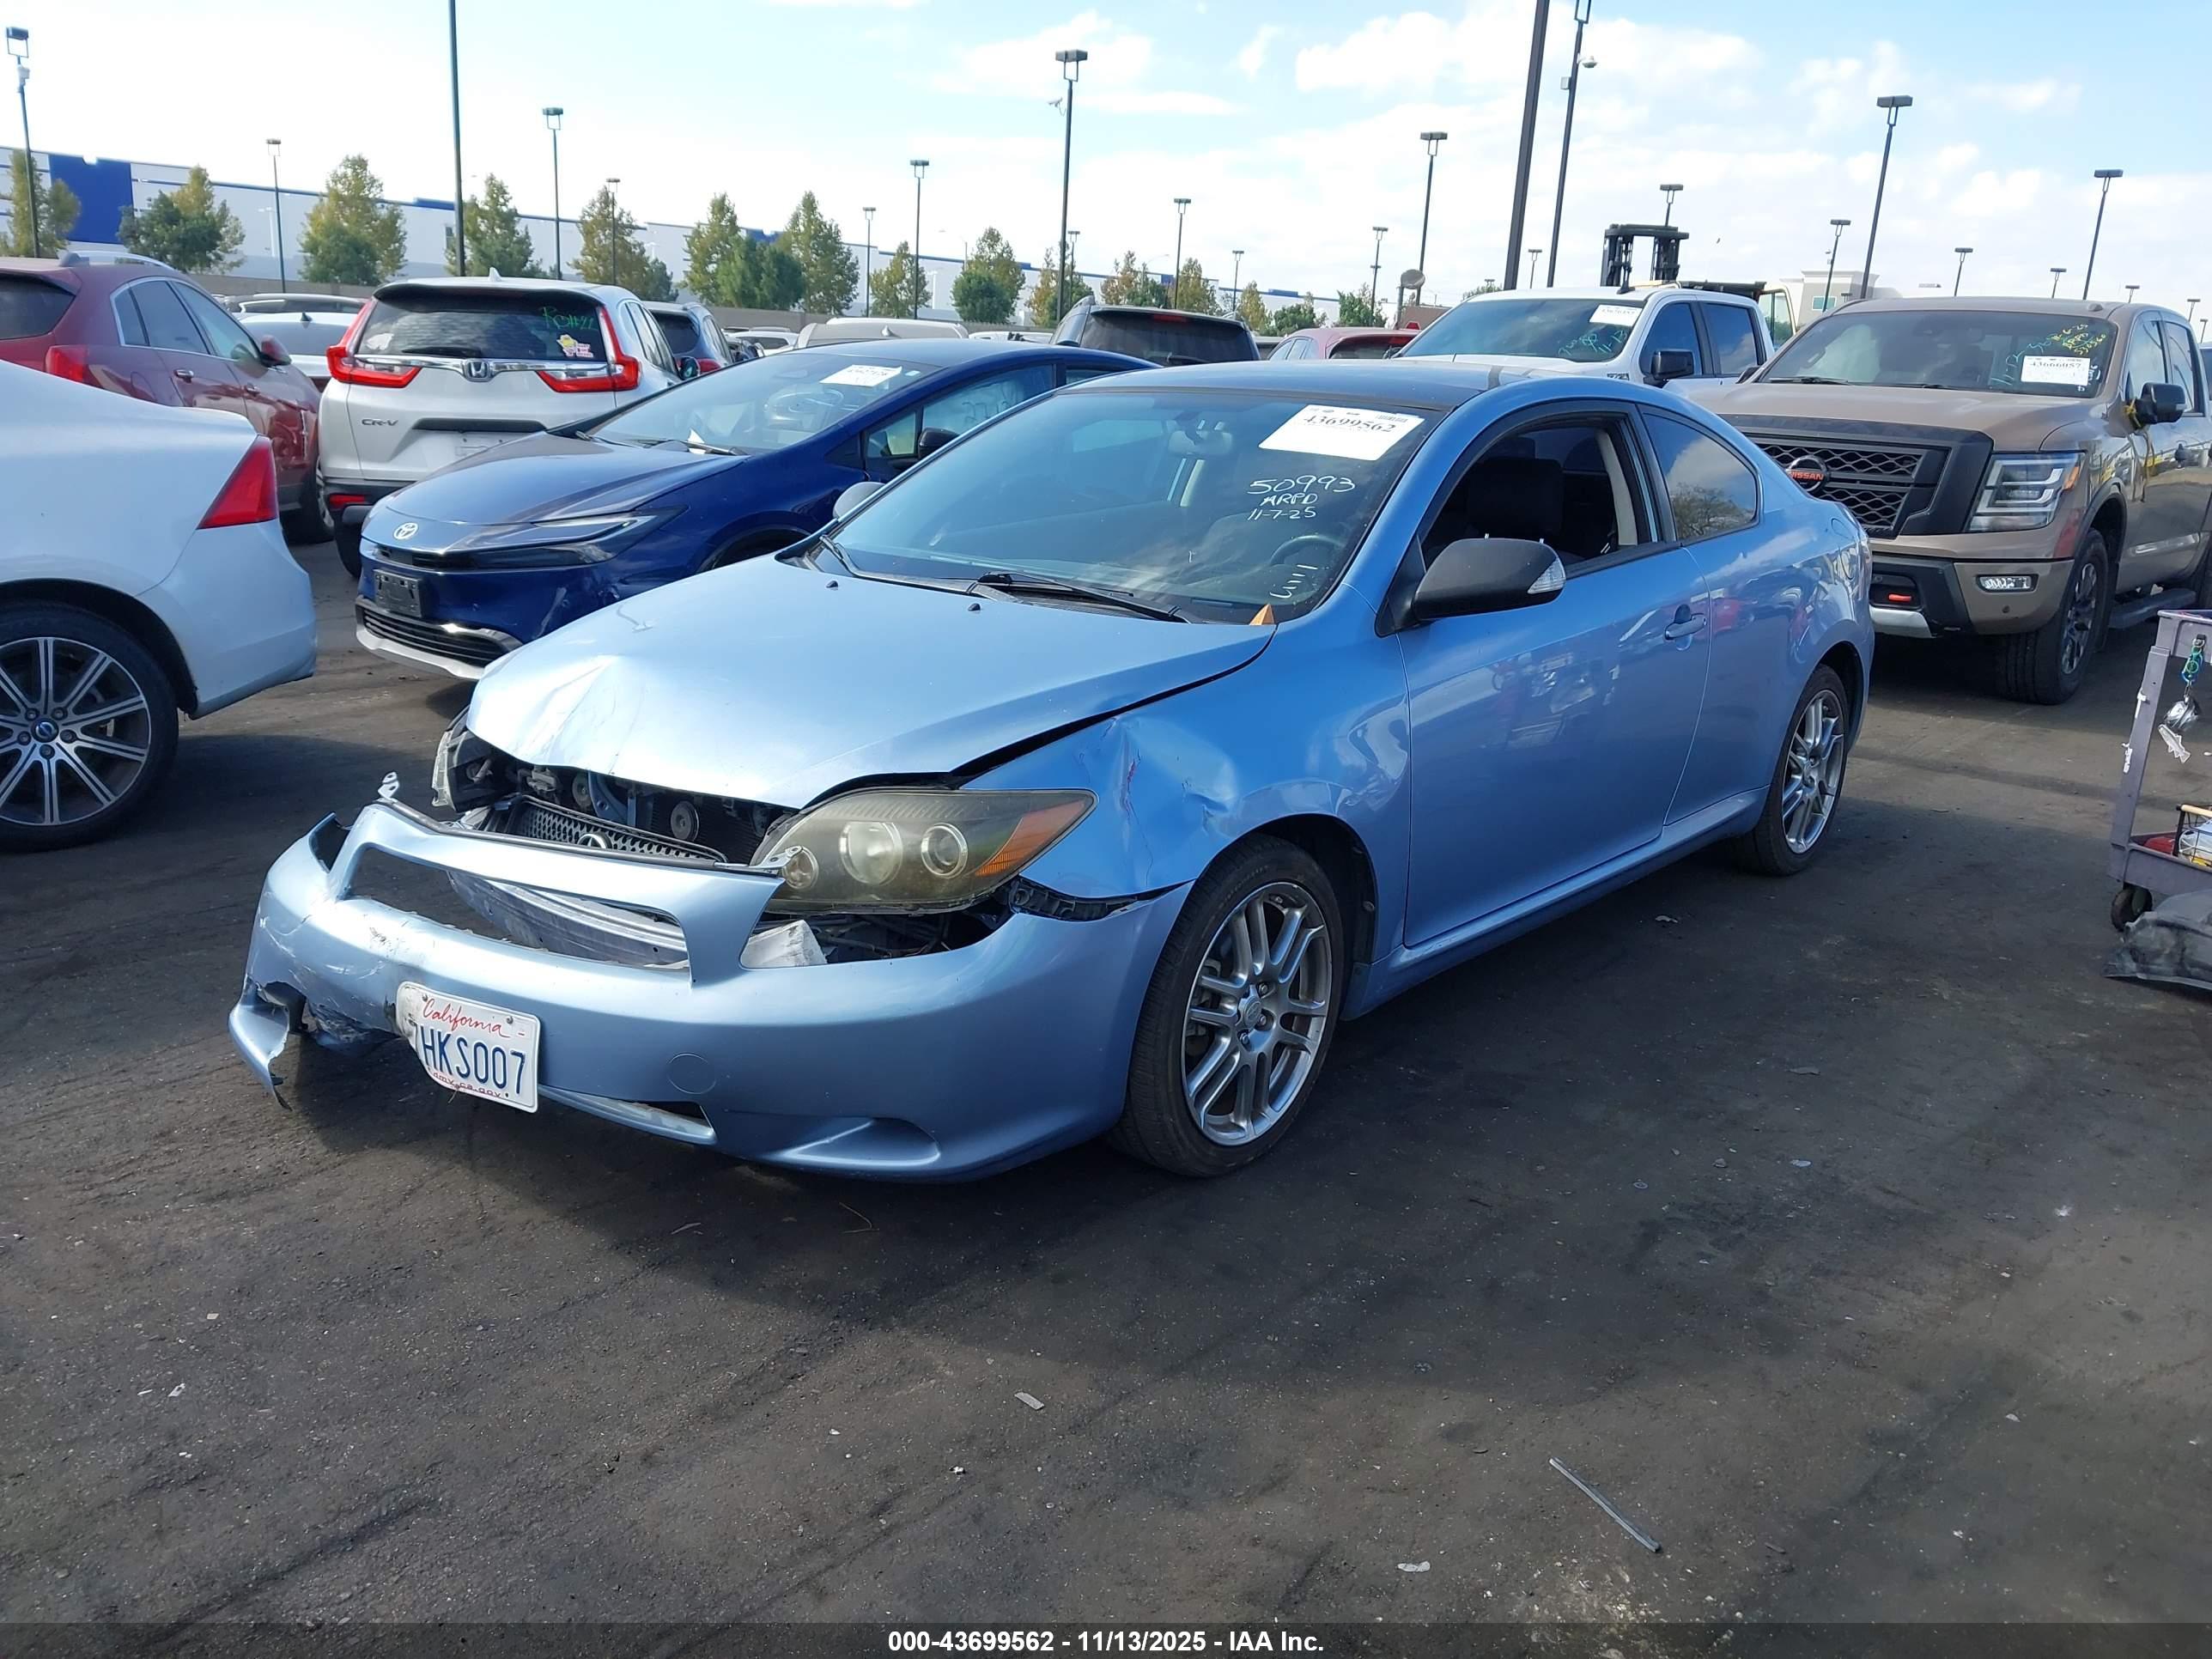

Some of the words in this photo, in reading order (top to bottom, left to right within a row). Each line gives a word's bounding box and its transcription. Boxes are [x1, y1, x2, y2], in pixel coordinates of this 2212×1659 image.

[1304, 415, 1396, 432] 43699562
[1247, 475, 1356, 495] 50993
[1260, 492, 1319, 507] ARPD
[1247, 507, 1317, 521] 11-7-25
[422, 998, 511, 1038] California
